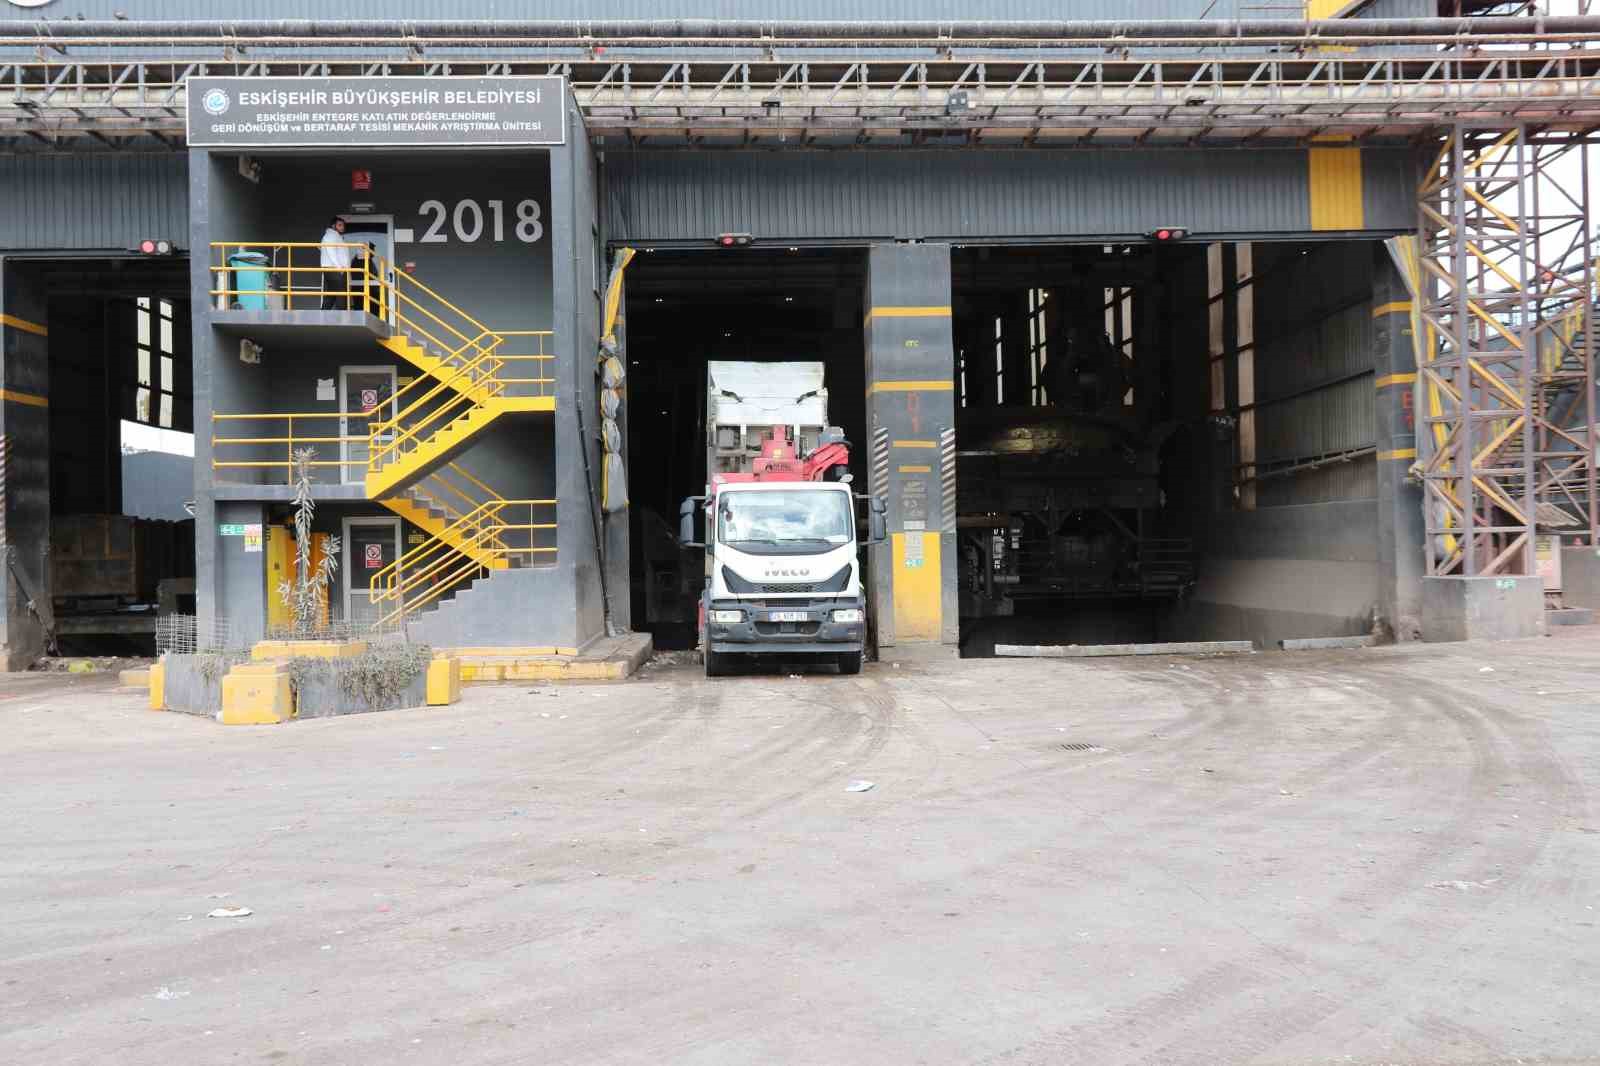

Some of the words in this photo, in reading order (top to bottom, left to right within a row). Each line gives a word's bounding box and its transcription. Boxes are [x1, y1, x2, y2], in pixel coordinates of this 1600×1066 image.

[239, 89, 328, 107] ESKİŞEHİR
[332, 88, 440, 107] BÜYÜKŞEHİR
[444, 88, 541, 104] BELEDİYESİ
[312, 113, 359, 121] ENTEGRE
[362, 112, 384, 121] KATI
[386, 112, 408, 121] ATIK
[411, 111, 496, 121] DEĞERLENDİRME
[211, 122, 235, 133] GERİ
[304, 123, 356, 132] BERTARAF
